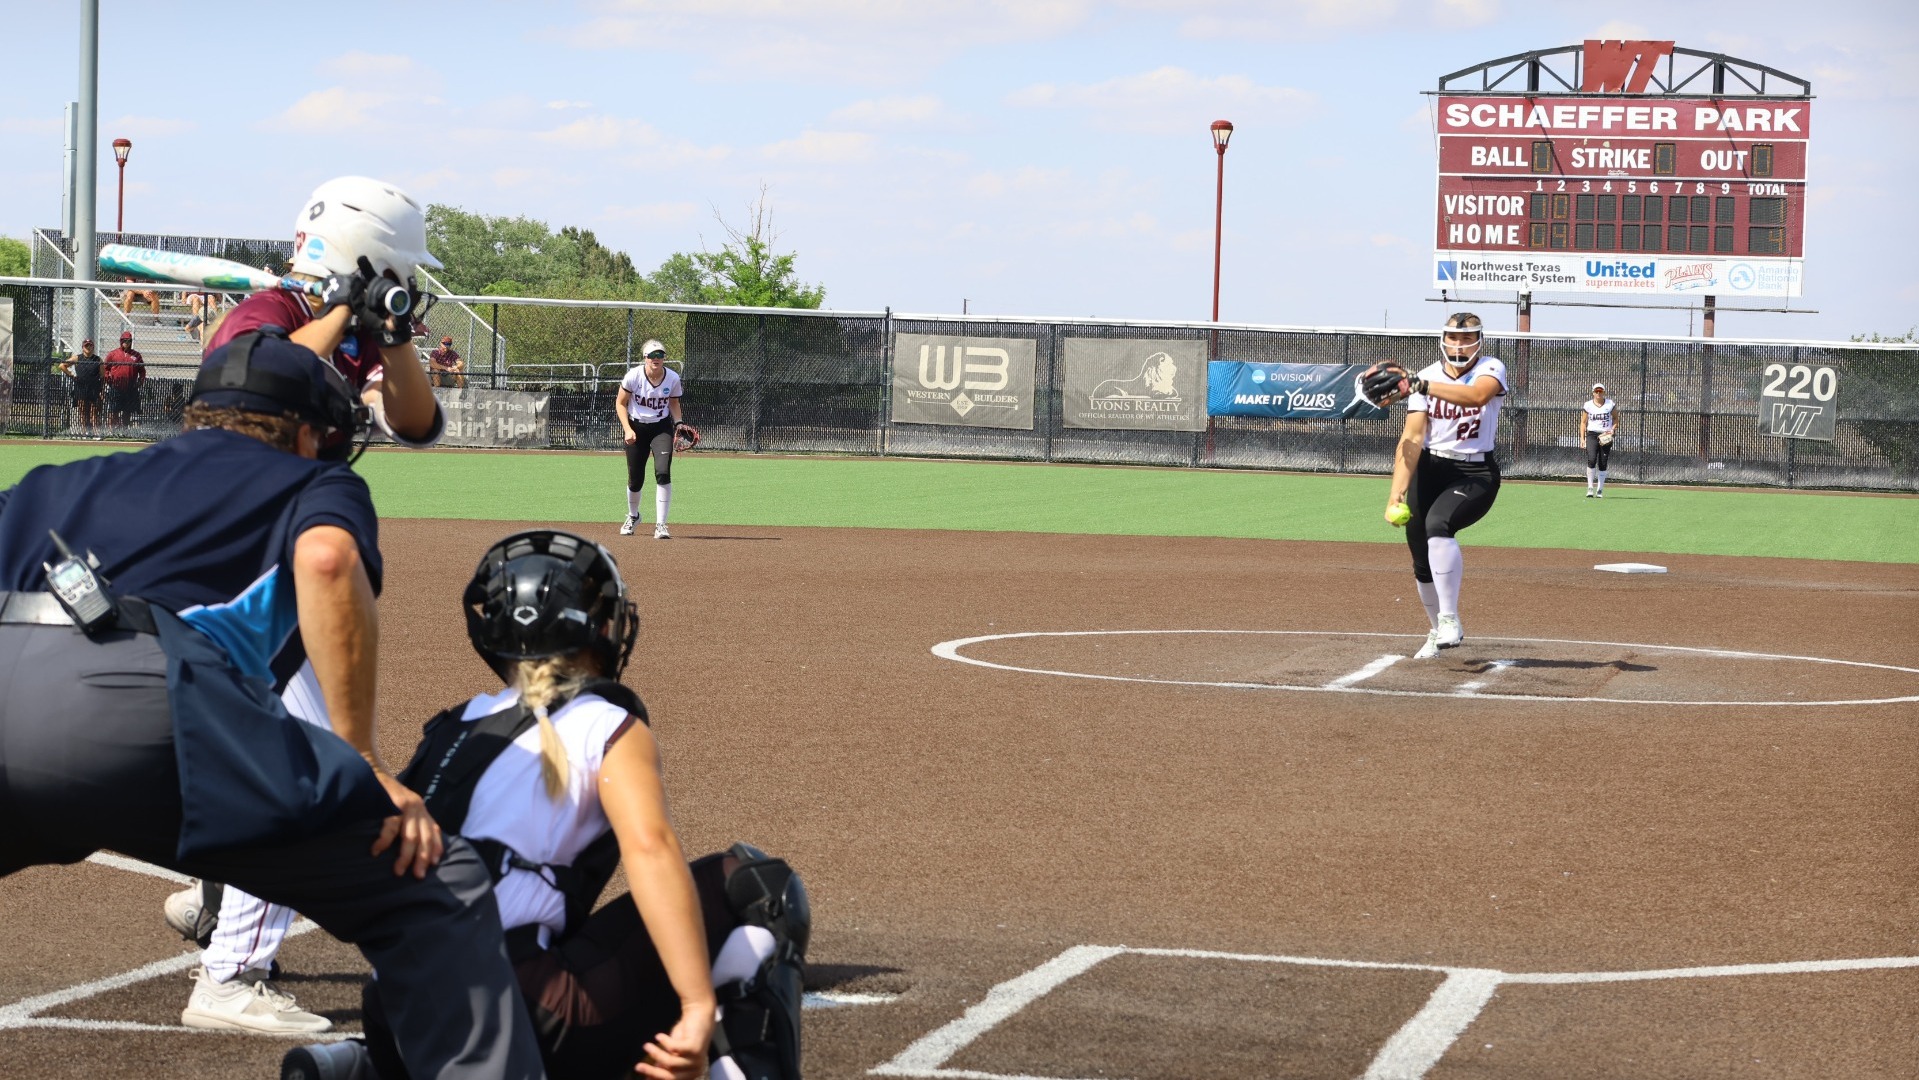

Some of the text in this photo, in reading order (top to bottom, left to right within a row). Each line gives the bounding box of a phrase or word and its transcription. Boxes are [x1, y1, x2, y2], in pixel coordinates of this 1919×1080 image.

[1582, 39, 1675, 93] WT
[1445, 103, 1802, 132] SCHAEFFER PARK
[1471, 146, 1529, 167] BALL
[1571, 147, 1651, 169] STRIKE
[1700, 149, 1748, 171] OUT
[1536, 179, 1789, 196] 1 2 3 4 5 6 7 8 9 TOTAL
[1444, 194, 1525, 217] VISITOR
[1449, 223, 1520, 245] HOME
[1460, 260, 1561, 272] Northwest Texas
[1586, 260, 1656, 279] United
[1664, 262, 1713, 289] PLAINS
[1460, 271, 1576, 285] Healthcare System
[1585, 278, 1656, 289] supermarkets
[1270, 373, 1313, 382] DIVISION
[1315, 374, 1321, 382] II
[1763, 363, 1837, 402] 220
[441, 400, 473, 410] ome
[476, 400, 492, 410] of
[495, 400, 524, 412] The
[635, 394, 670, 411] EAGLES
[906, 389, 1019, 404] WESTERN BUILDERS
[1090, 399, 1181, 412] LYONS REALTY
[1234, 394, 1270, 405] MAKE
[1272, 395, 1284, 405] IT
[444, 416, 492, 438] erin'
[1770, 403, 1824, 436] WT
[1456, 418, 1481, 441] 22
